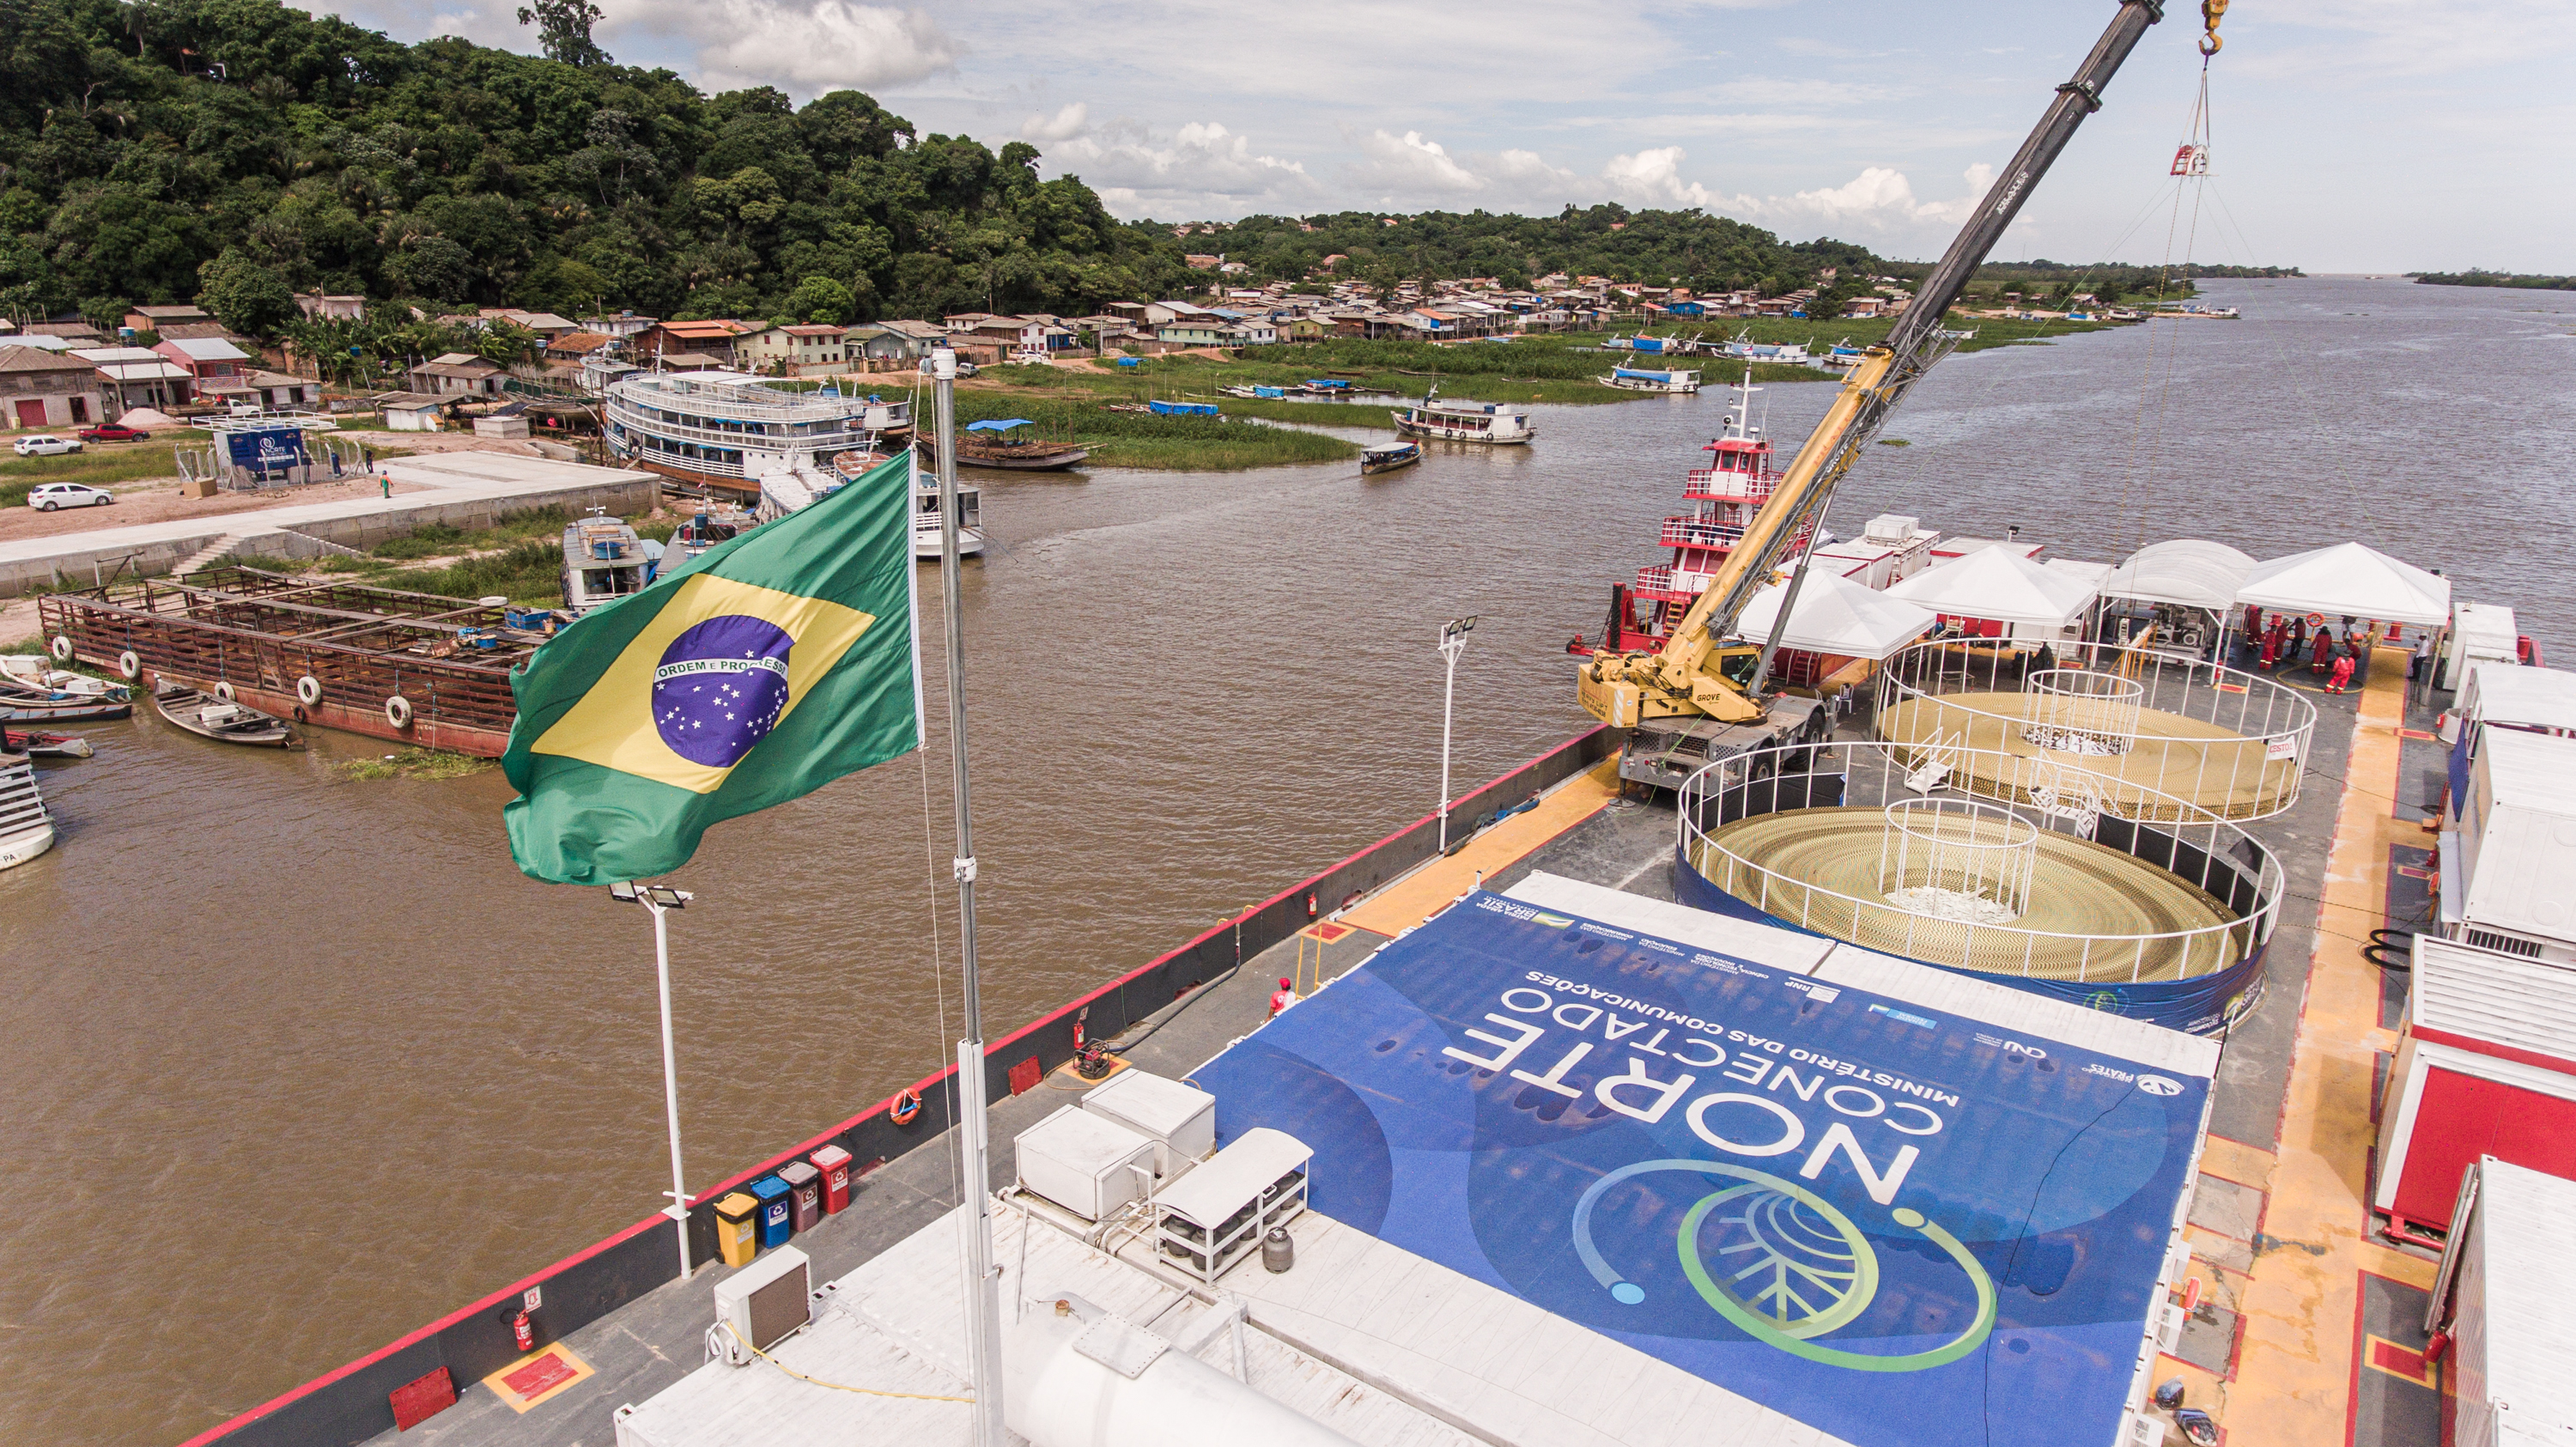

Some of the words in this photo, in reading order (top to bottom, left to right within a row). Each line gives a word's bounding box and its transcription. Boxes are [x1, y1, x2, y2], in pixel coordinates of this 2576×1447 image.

[1996, 171, 2028, 212] PRATES
[659, 661, 706, 678] ORDEM
[2269, 744, 2289, 753] CESTO
[1476, 903, 1504, 913] AMADA
[1484, 898, 1536, 917] BRASIL
[1504, 910, 1529, 921] PÁTRIA
[1582, 922, 1634, 939] COMUNICAÇÕES
[1592, 929, 1627, 941] MINISTÉRIO
[1641, 938, 1678, 951] EDUCAÇÃO
[1648, 945, 1686, 957] MINISTÉRIO
[1696, 953, 1735, 966] INOVAÇÕES
[1701, 962, 1739, 975] MINISTÉRIO
[1784, 980, 1811, 991] RNP
[1525, 970, 1724, 1035] COMUNICAÇÕES
[1728, 1033, 1785, 1055] DAS
[2003, 1040, 2047, 1059] CNJ
[1500, 988, 1943, 1135] CONECTADO
[1789, 1048, 1959, 1108] MINISTÉRIO
[2090, 1063, 2135, 1081] PRATES
[1441, 1012, 1920, 1206] NORTE
